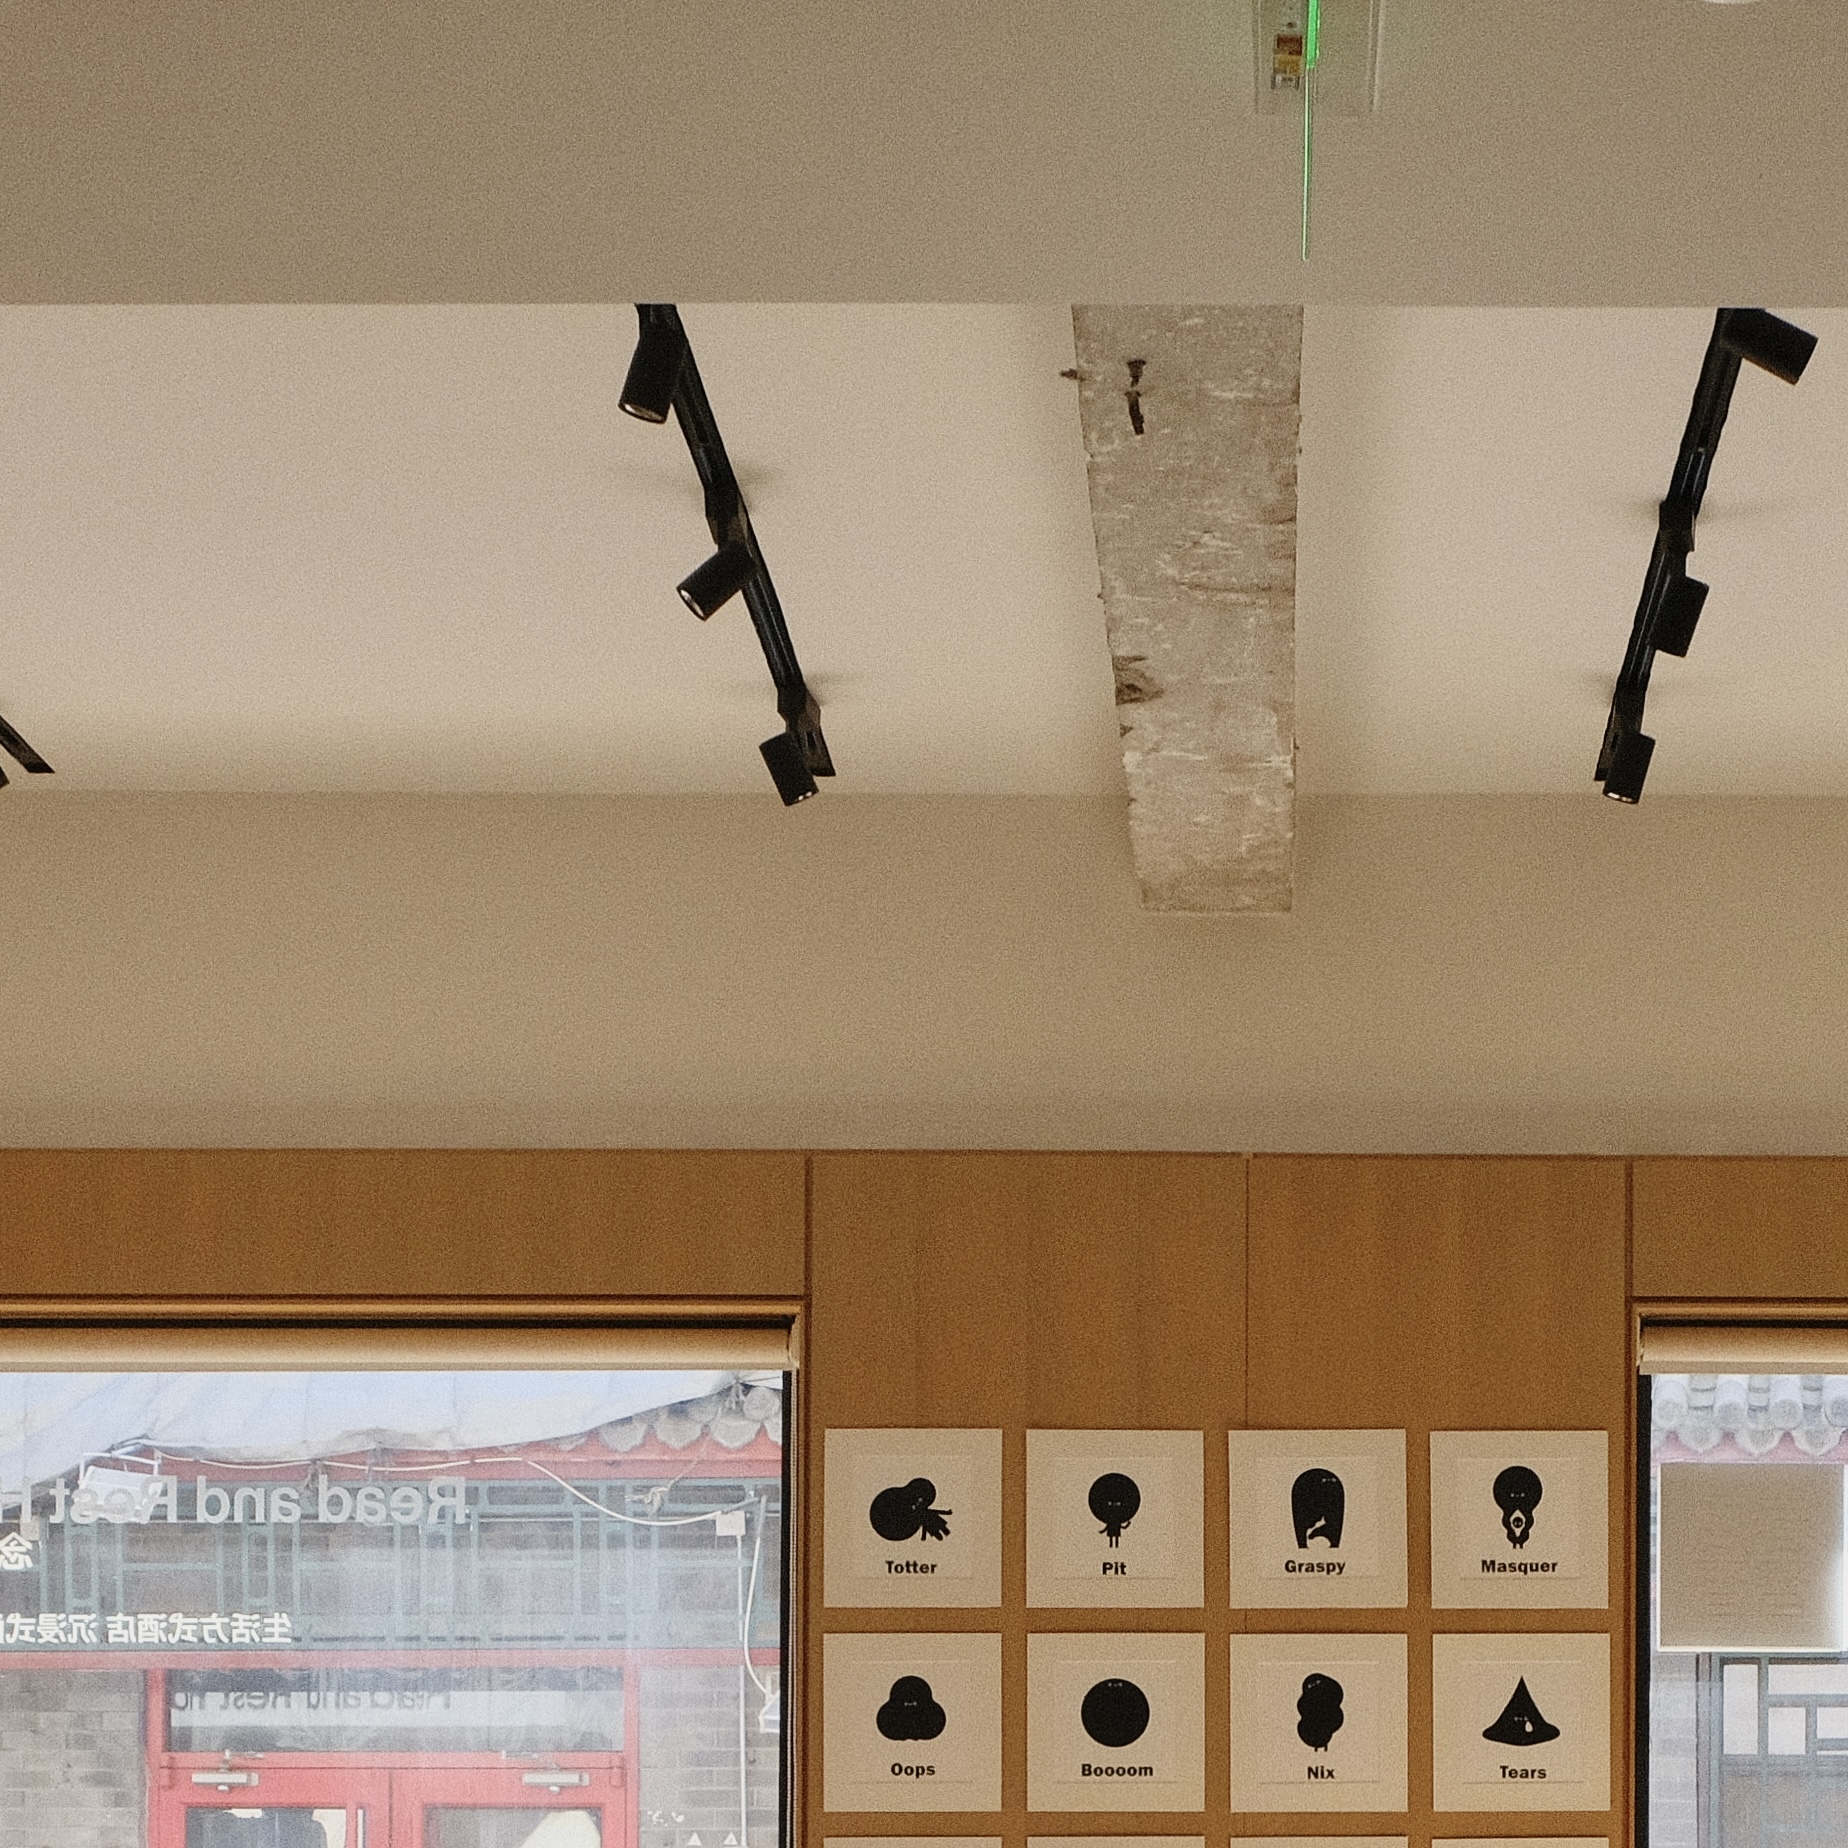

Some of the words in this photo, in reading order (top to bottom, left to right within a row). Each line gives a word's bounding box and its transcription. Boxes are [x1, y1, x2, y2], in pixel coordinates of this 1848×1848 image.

[885, 1560, 937, 1574] Totter
[1102, 1561, 1127, 1576] Pit
[1284, 1559, 1346, 1575] Graspy
[1481, 1559, 1558, 1576] Masquer
[890, 1762, 936, 1779] Oops
[1081, 1763, 1154, 1777] Boooom
[1307, 1766, 1335, 1779] Nix
[1500, 1765, 1547, 1779] Tears
